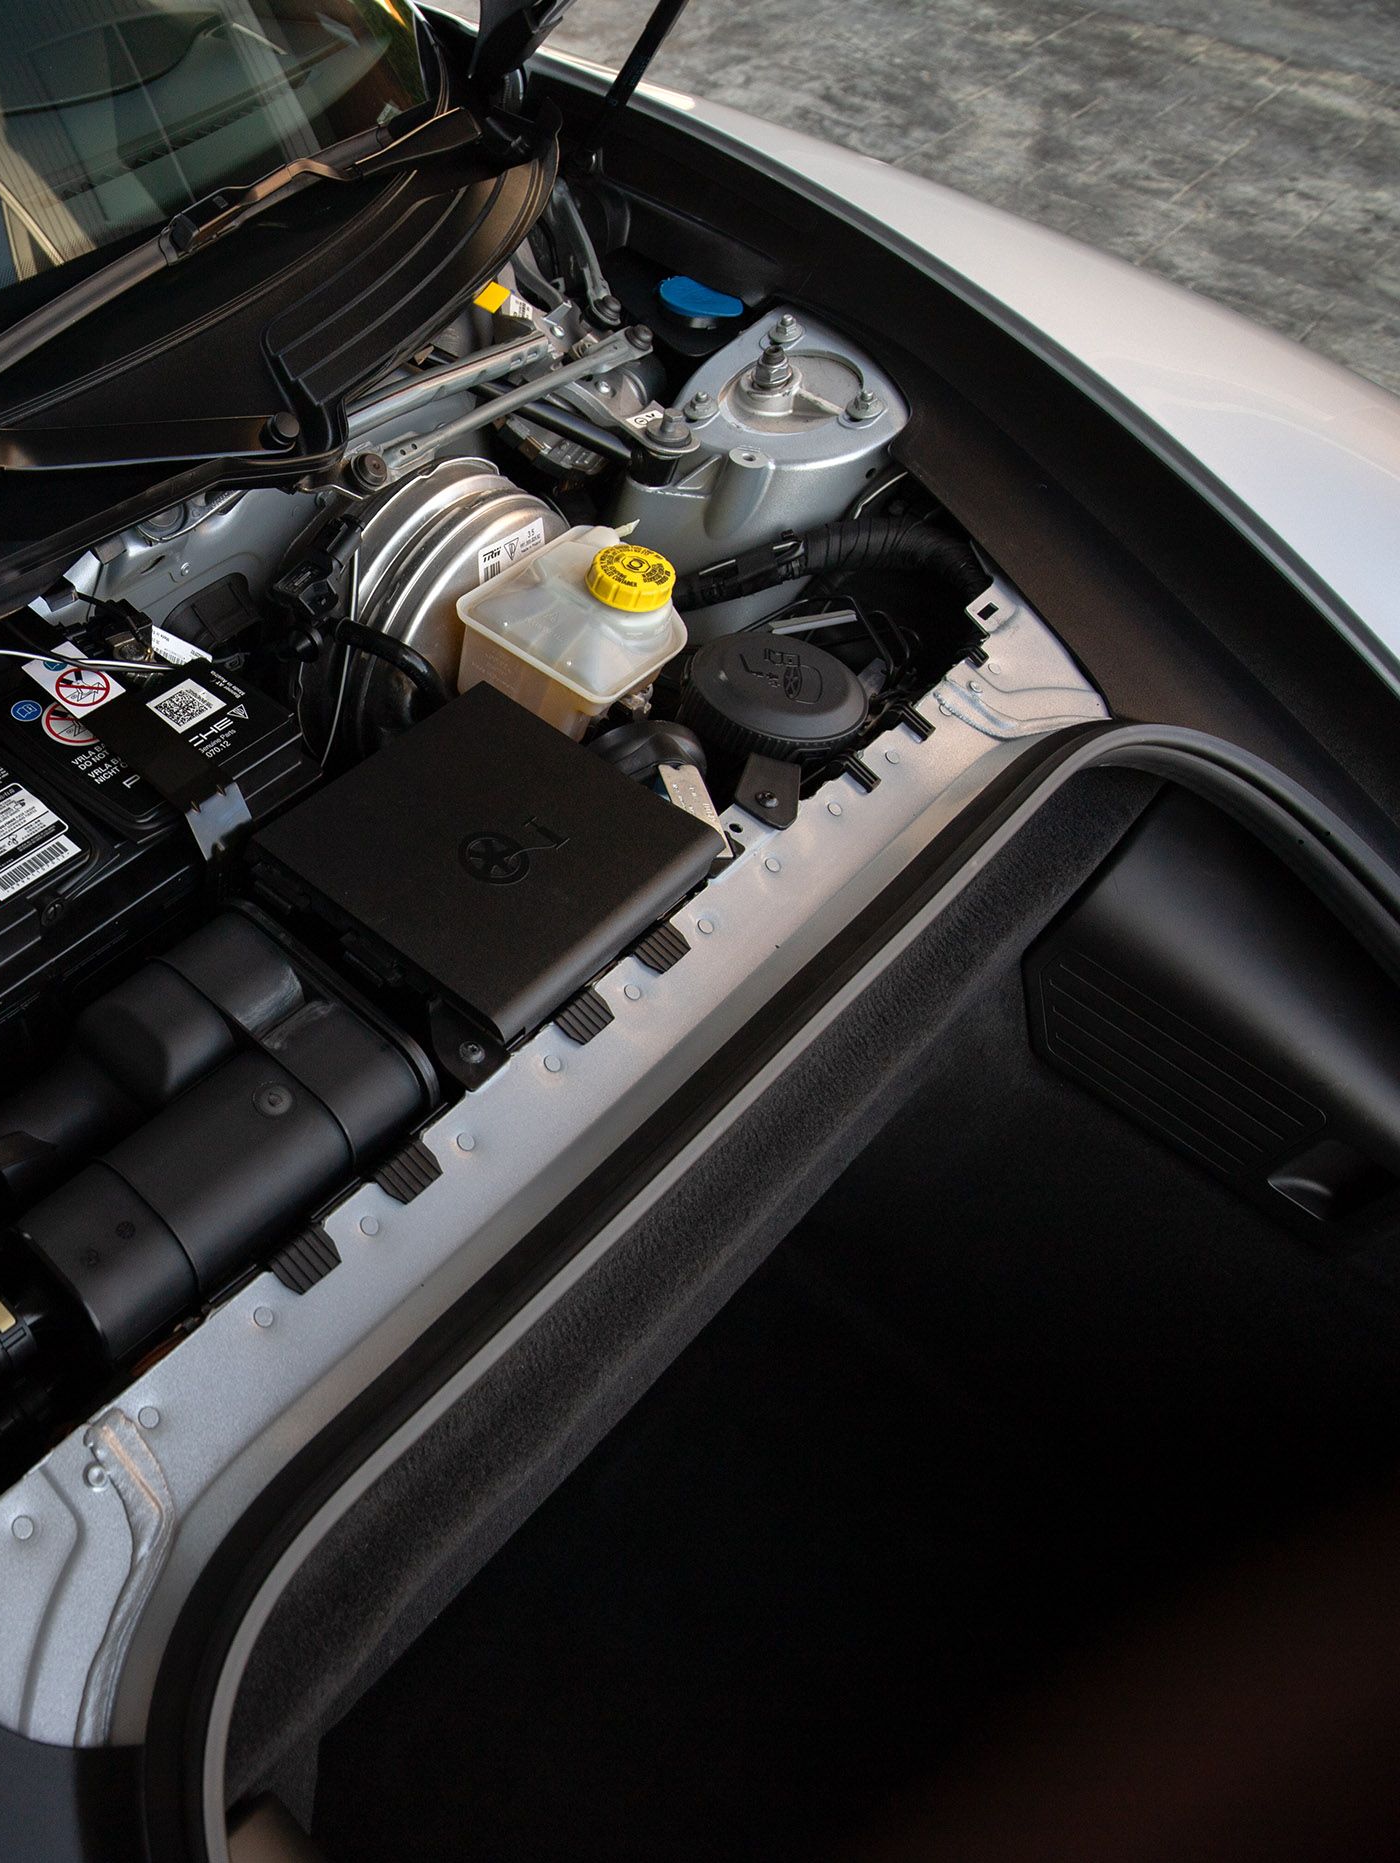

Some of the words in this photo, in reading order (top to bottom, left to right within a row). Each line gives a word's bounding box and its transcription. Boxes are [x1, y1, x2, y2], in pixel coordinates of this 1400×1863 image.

[219, 729, 237, 740] Parts
[205, 740, 232, 759] 070.12
[78, 760, 93, 771] DO
[91, 750, 110, 763] NOT
[94, 766, 120, 785] NICHT
